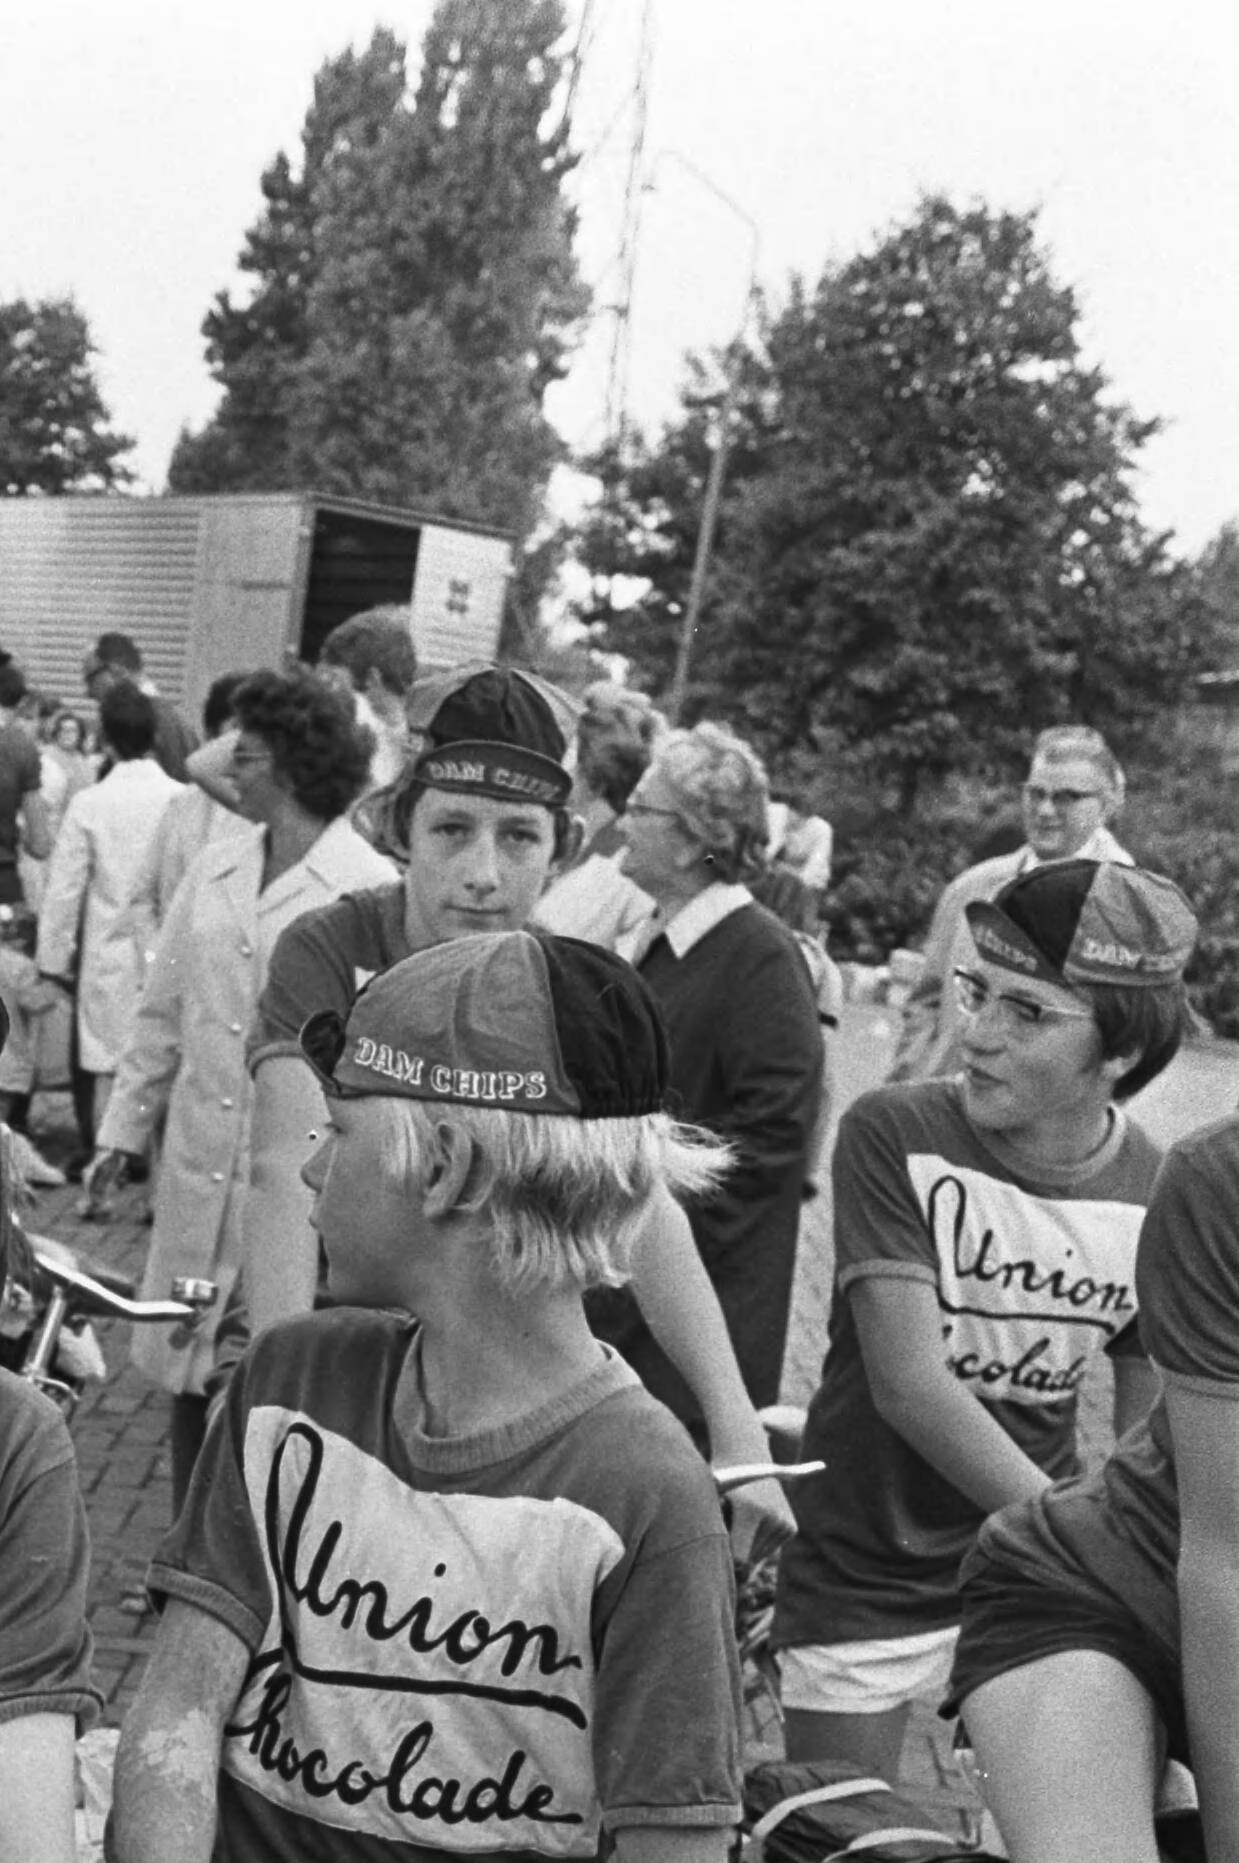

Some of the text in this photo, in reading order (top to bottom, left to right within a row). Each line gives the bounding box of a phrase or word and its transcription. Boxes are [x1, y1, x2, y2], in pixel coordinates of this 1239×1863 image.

[426, 760, 486, 782] DAM
[354, 1036, 547, 1100] DAM CHIPS
[927, 1174, 1134, 1336] Union
[945, 1336, 1087, 1392] colad
[264, 1421, 588, 1731] Union
